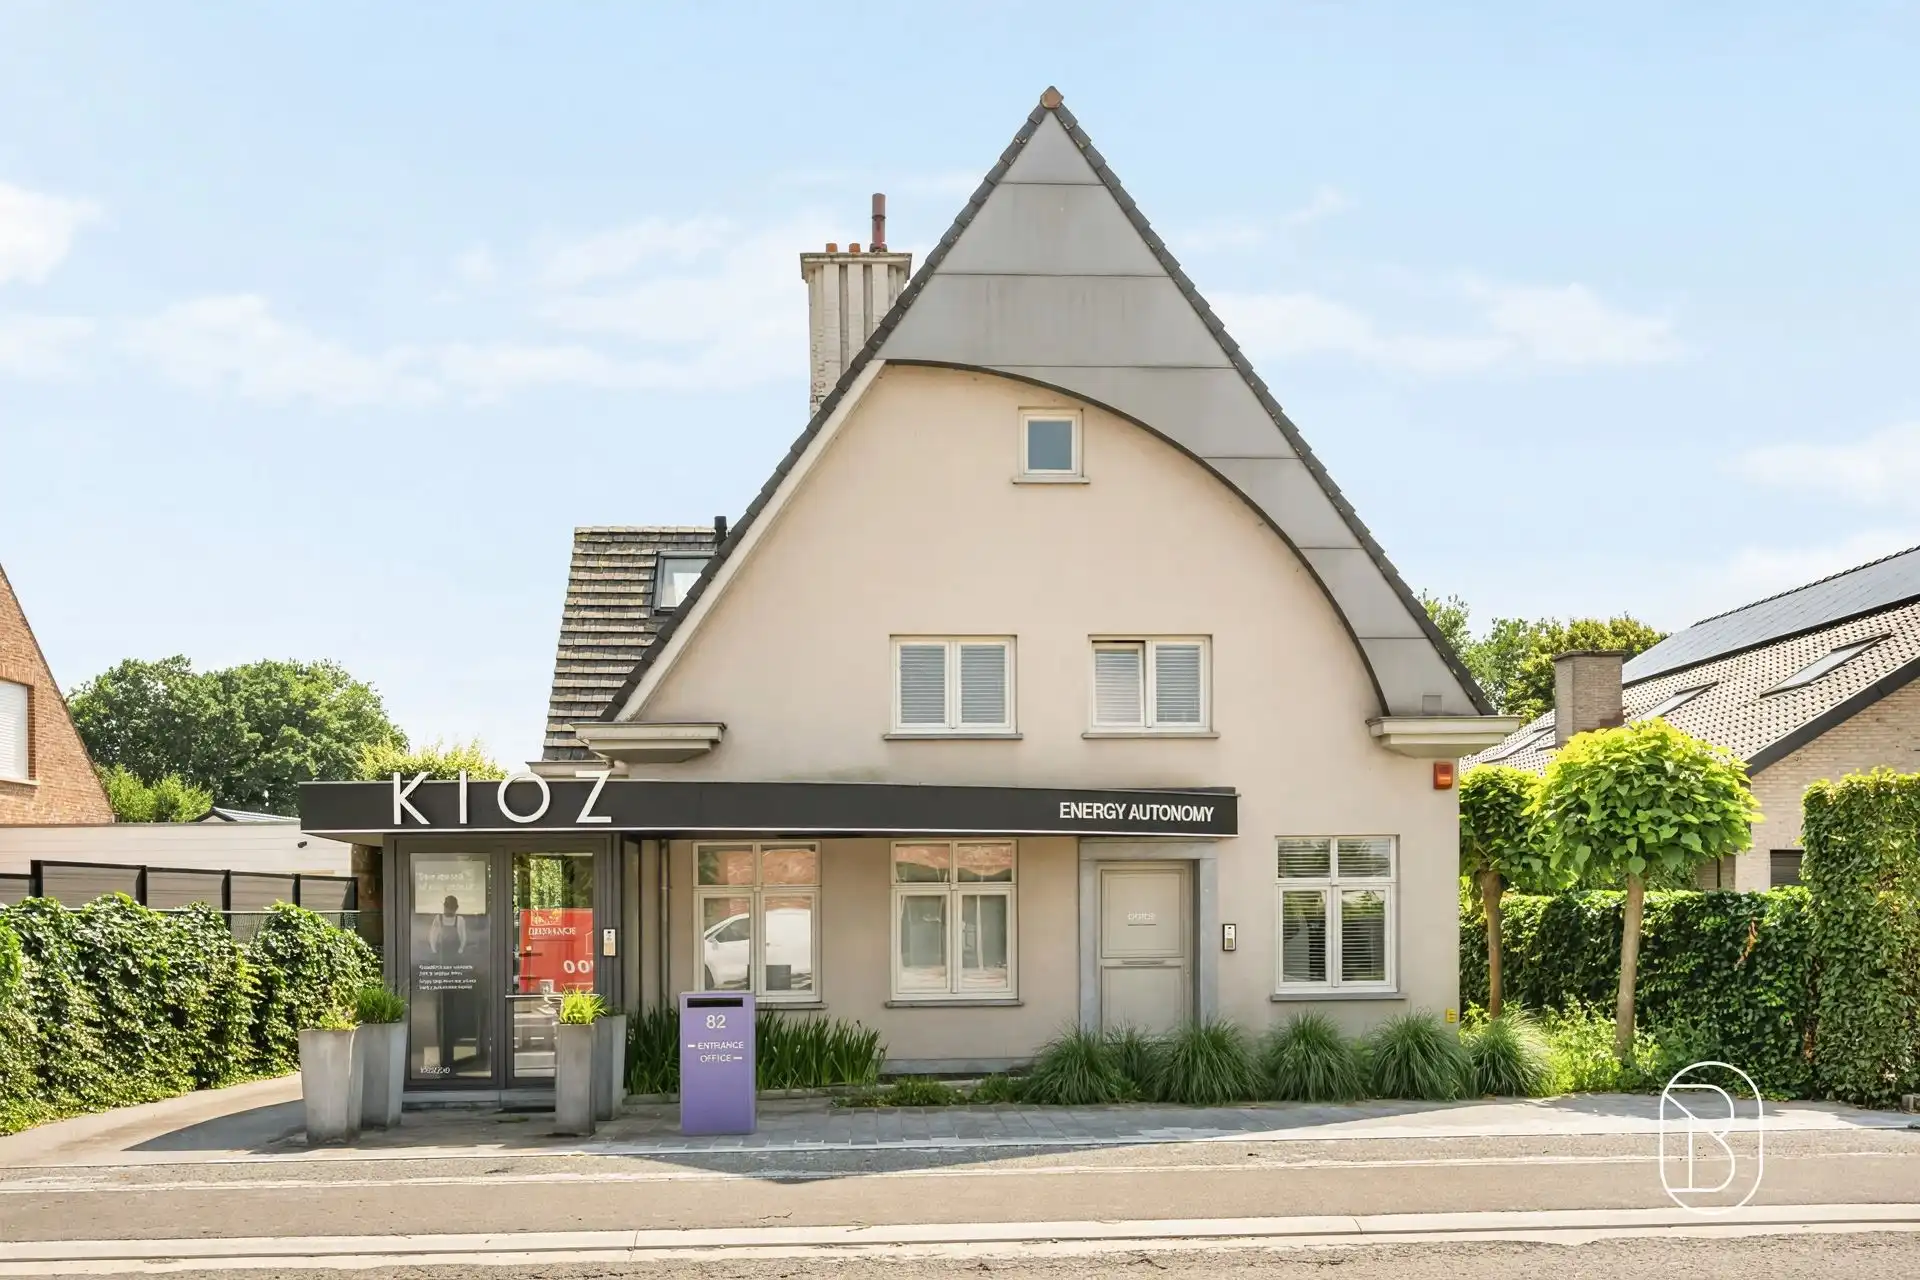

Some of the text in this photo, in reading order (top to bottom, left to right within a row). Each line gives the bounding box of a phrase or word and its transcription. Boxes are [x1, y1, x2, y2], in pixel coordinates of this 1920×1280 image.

[393, 771, 612, 825] KIOZ
[1059, 802, 1215, 822] ENERGY AUTONOMY
[706, 1014, 726, 1029] 82
[697, 1041, 744, 1050] ENTRANCE
[700, 1054, 731, 1063] OFFICE
